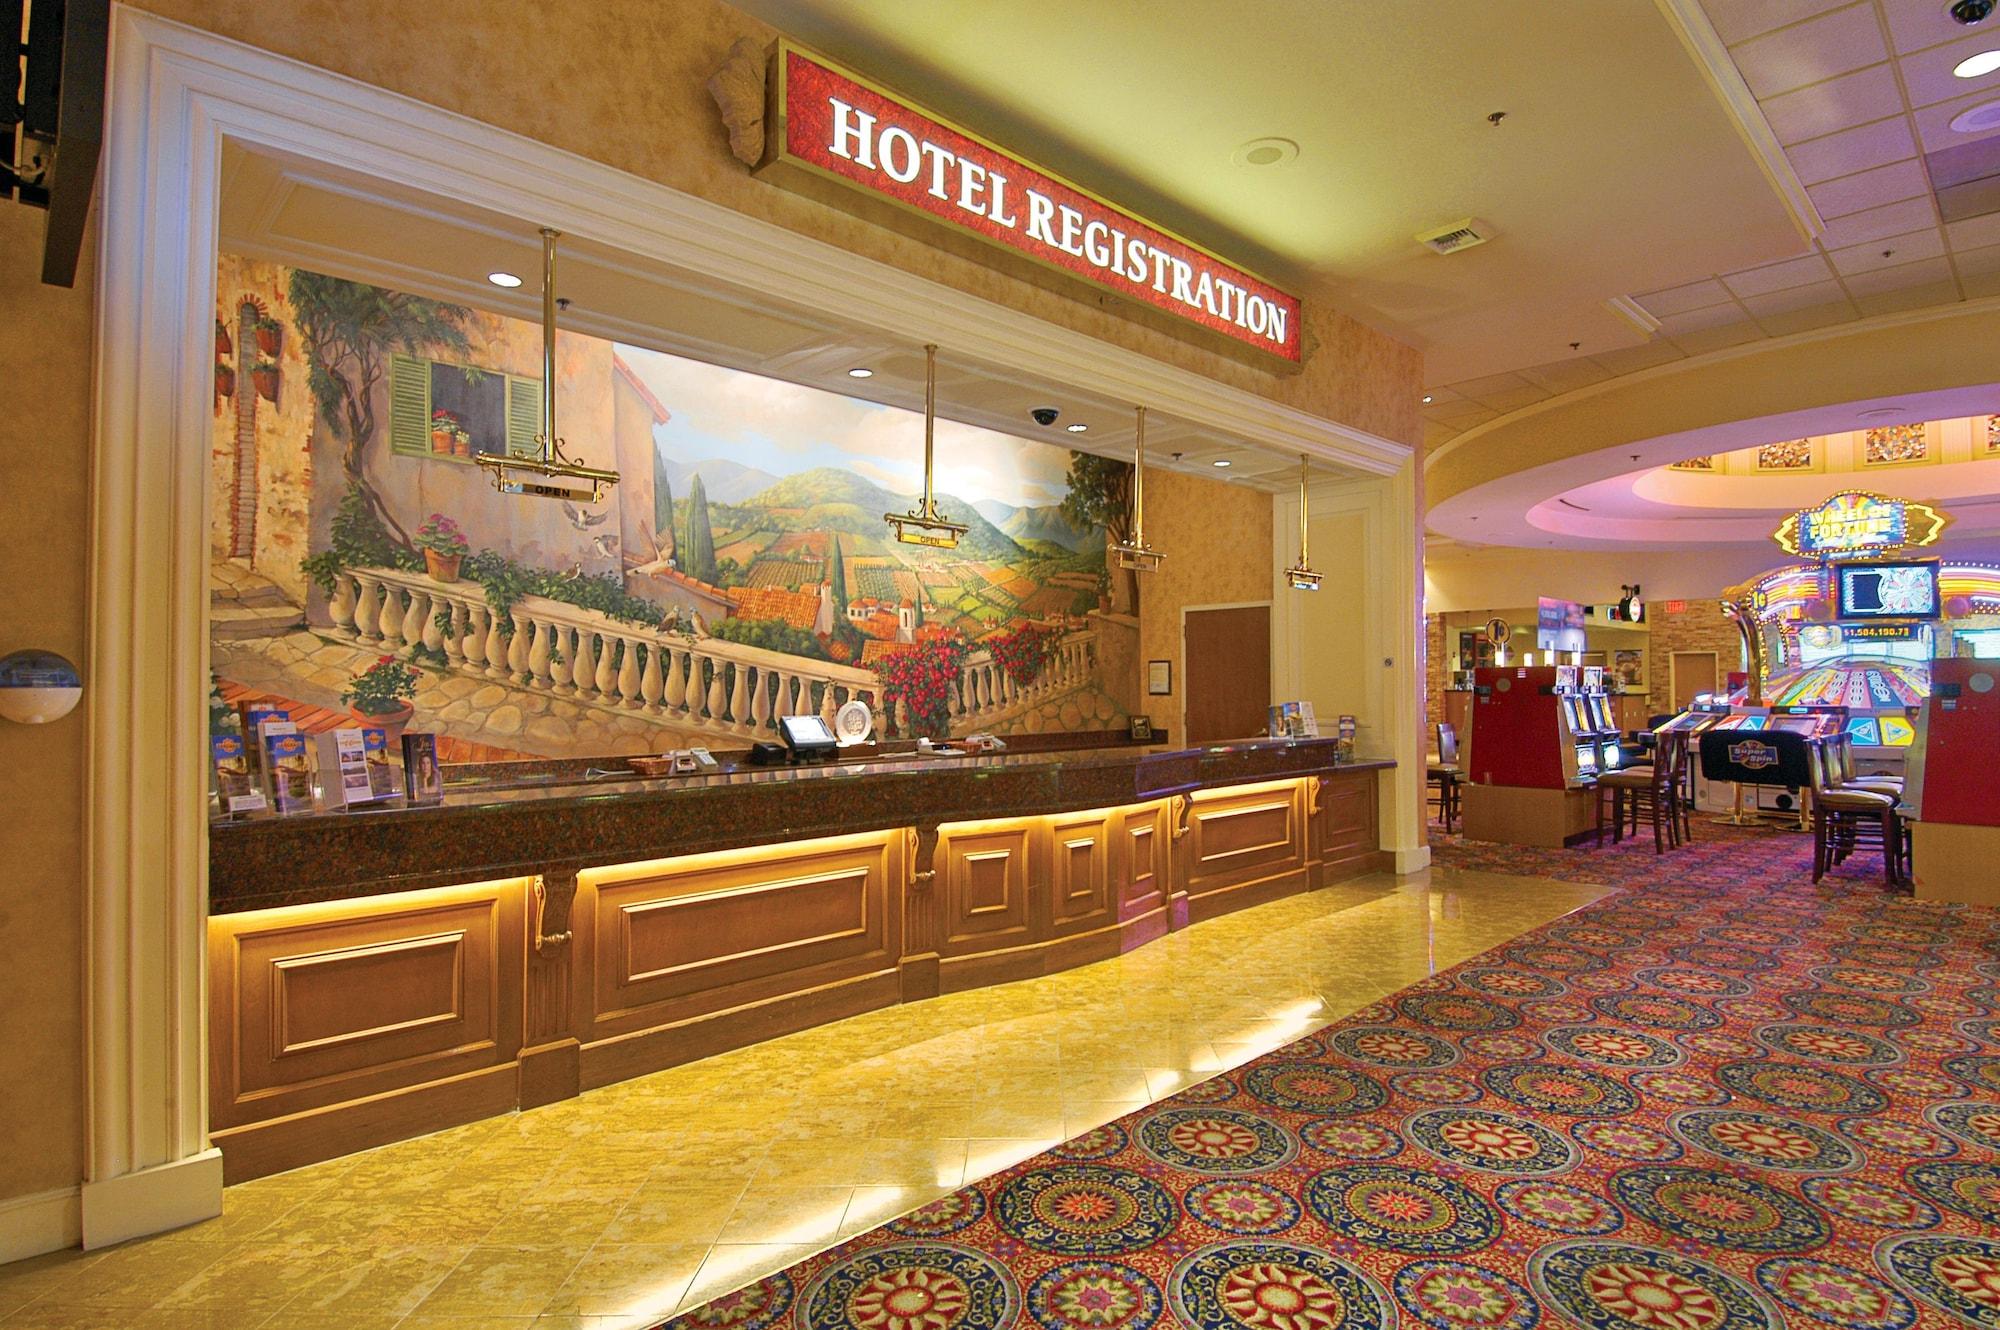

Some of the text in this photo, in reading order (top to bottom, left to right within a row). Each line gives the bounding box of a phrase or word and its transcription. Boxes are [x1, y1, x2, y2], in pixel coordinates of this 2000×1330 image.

[828, 97, 1286, 344] HOTEL REGISTRATION
[535, 485, 570, 497] OPEN
[1809, 507, 1868, 525] WHEEL
[1809, 518, 1891, 539] FORTUNE
[920, 536, 940, 545] OPEN
